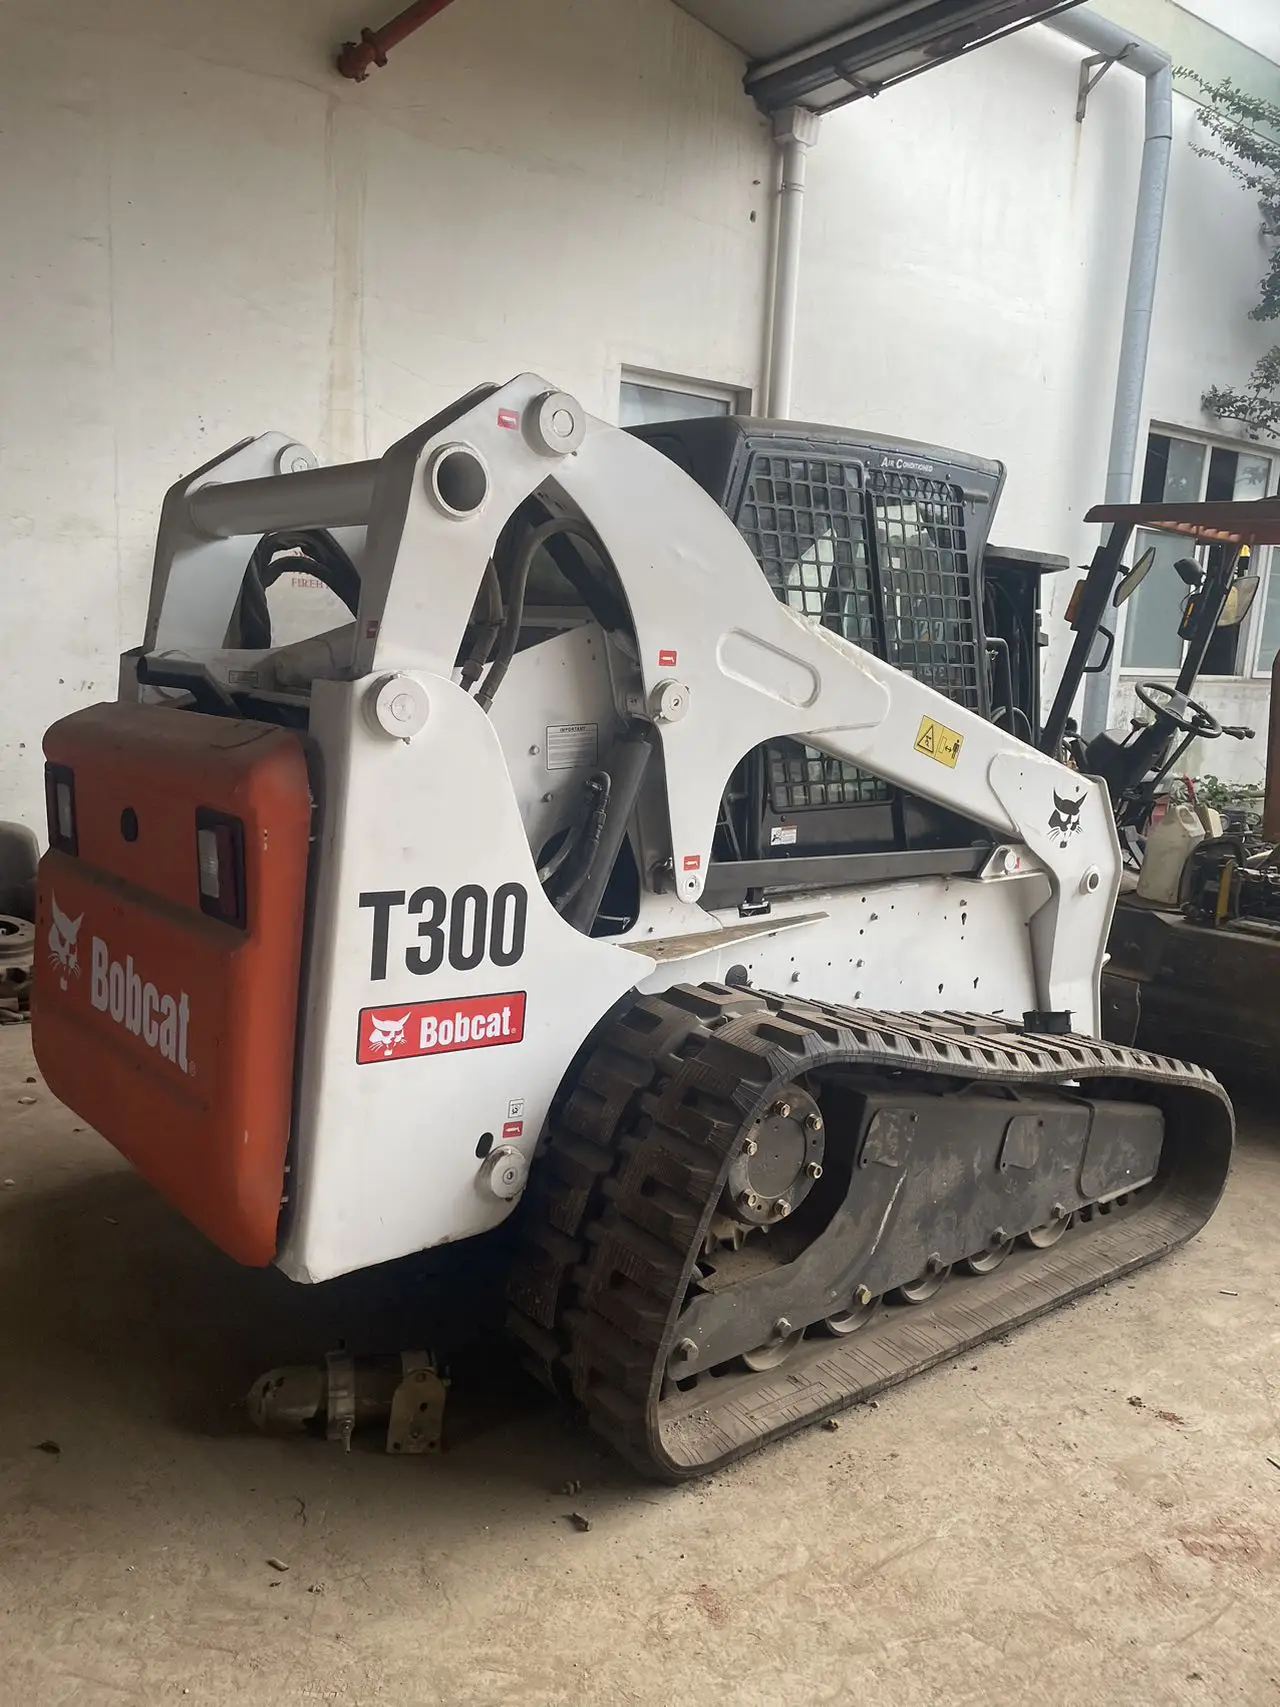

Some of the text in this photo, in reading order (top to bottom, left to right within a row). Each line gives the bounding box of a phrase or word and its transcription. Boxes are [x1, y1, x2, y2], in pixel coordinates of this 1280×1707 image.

[291, 577, 329, 589] FIREH
[358, 882, 528, 981] T300
[91, 935, 189, 1074] Bobcat
[419, 1006, 511, 1049] Bobcat
